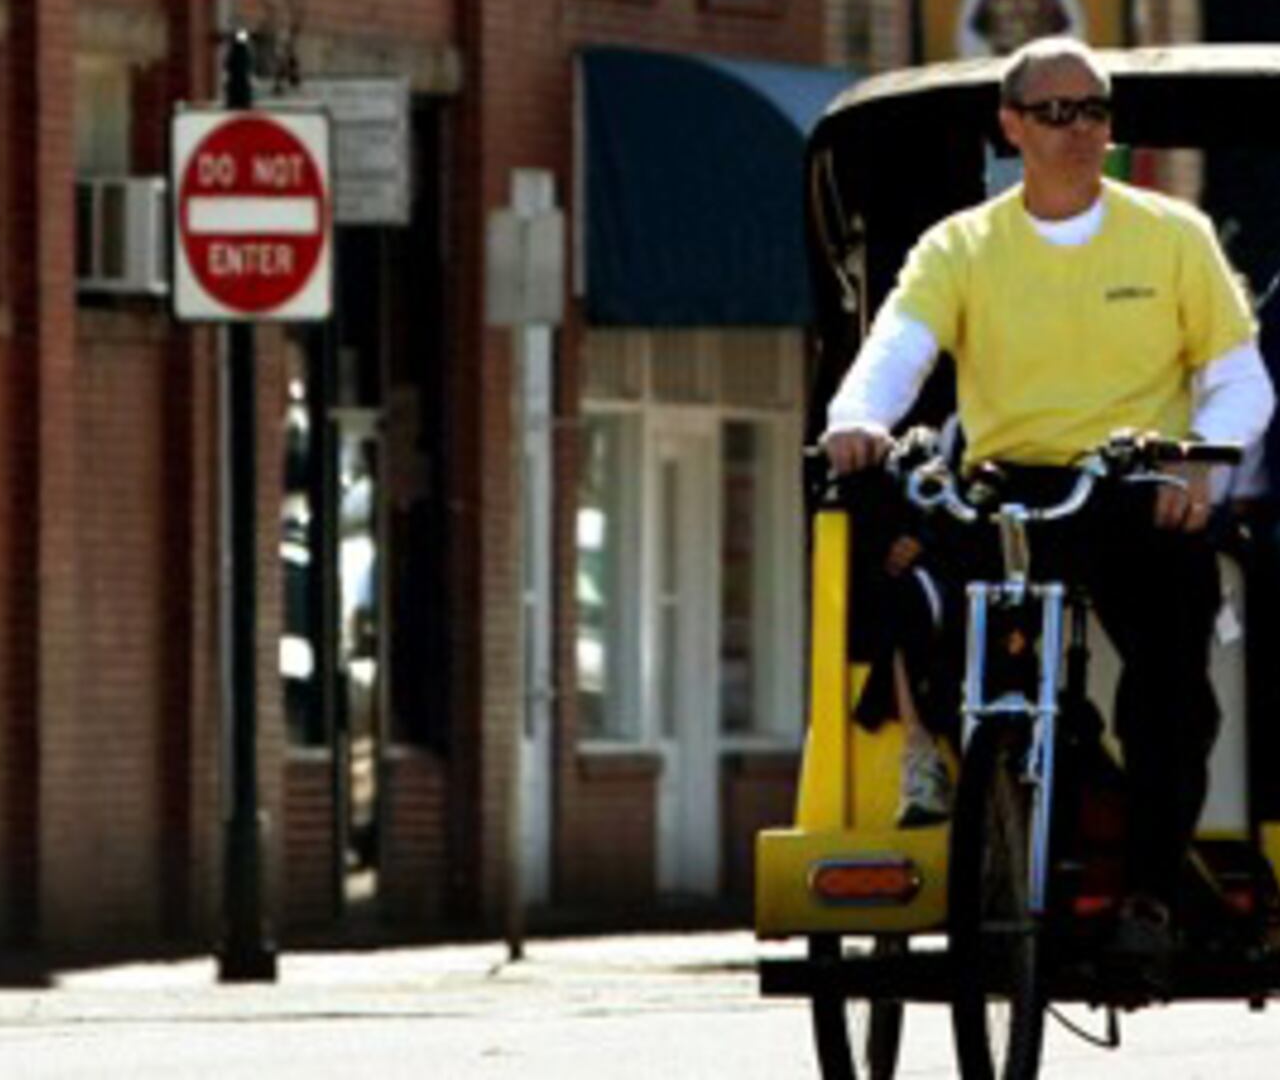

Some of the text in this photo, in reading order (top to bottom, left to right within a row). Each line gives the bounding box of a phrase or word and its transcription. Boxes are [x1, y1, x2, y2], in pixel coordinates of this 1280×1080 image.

[197, 151, 304, 188] DO NOT
[207, 242, 294, 277] ENTER
